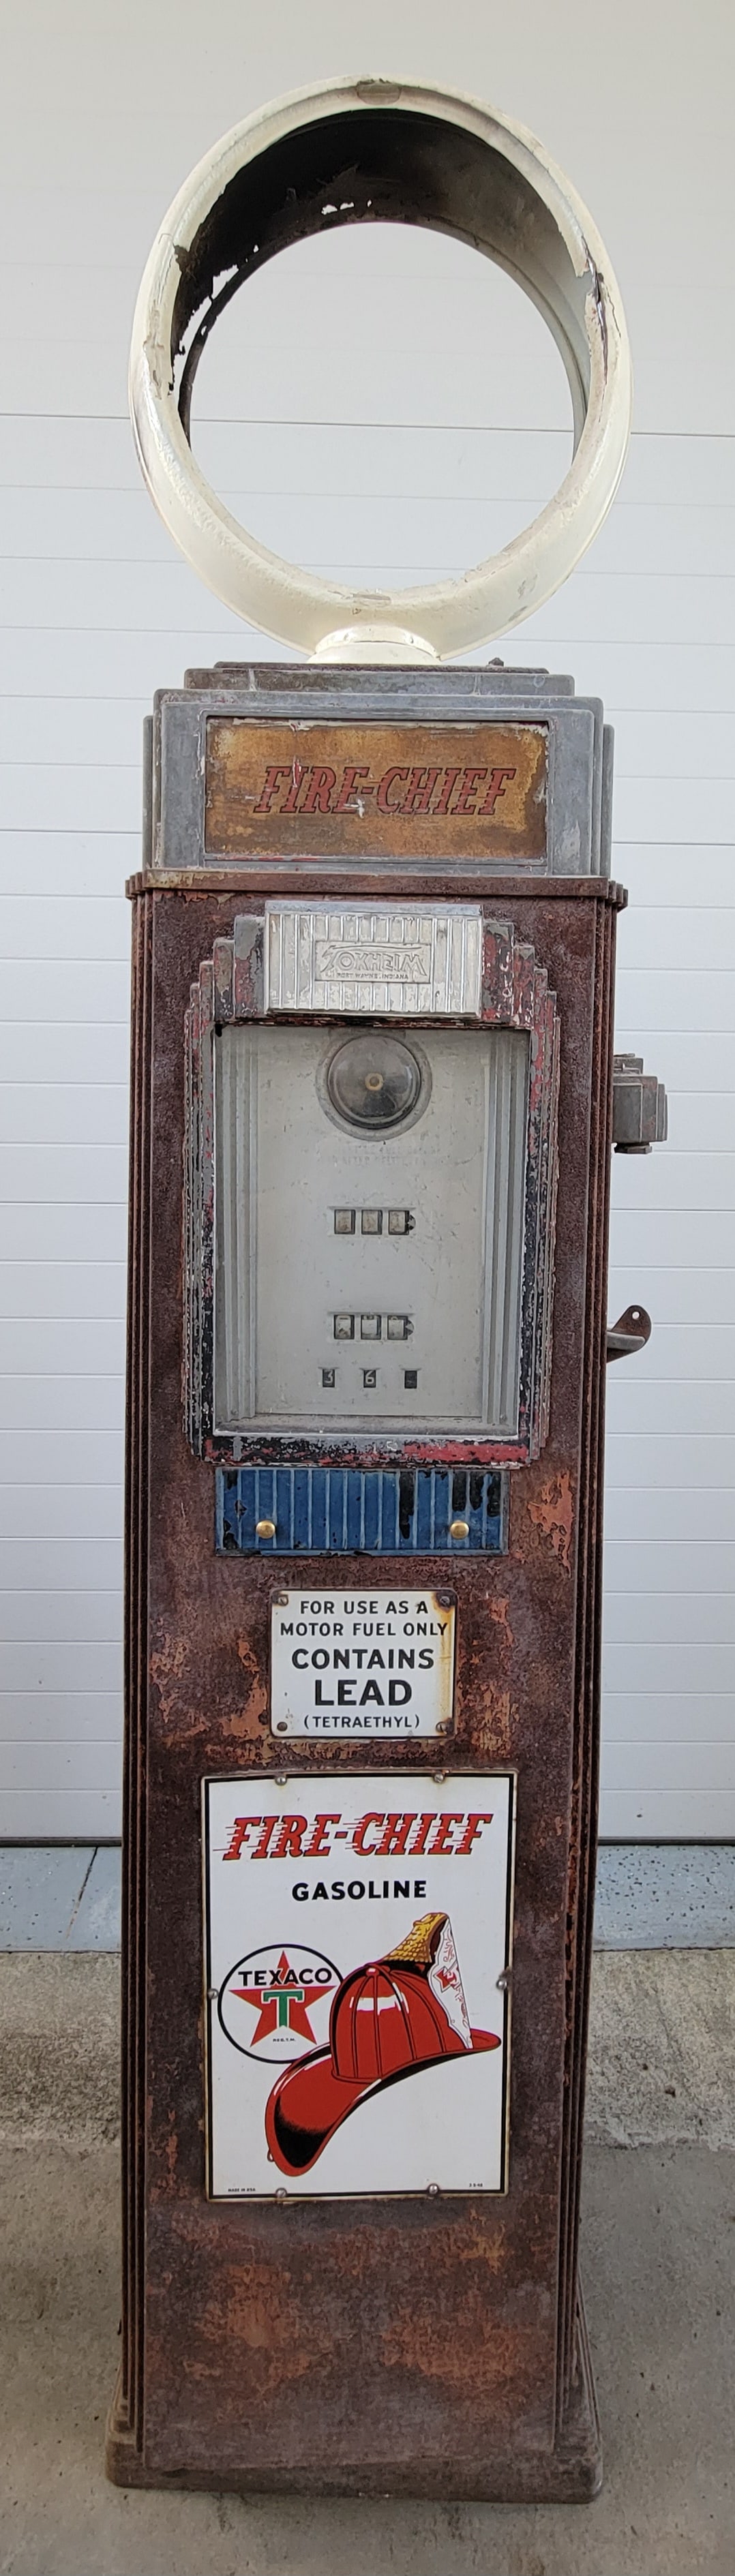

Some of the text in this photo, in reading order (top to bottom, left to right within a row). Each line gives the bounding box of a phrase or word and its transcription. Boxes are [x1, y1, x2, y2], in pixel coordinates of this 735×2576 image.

[254, 766, 516, 815] FIRE-CHIEF
[320, 945, 428, 976] TOKHEIM
[365, 1369, 375, 1384] 6
[300, 1601, 428, 1614] FOR USE AS A
[280, 1622, 448, 1636] MOTOR FUEL ONLY
[292, 1648, 434, 1669] CONTAINS
[314, 1679, 412, 1706] LEAD
[304, 1714, 420, 1729] (TETRAETHYL)
[222, 1812, 494, 1861] FIRE-CHIEF
[292, 1880, 427, 1901] GASOLINE
[238, 1967, 332, 1986] TEXACO
[262, 1990, 304, 2028] T
